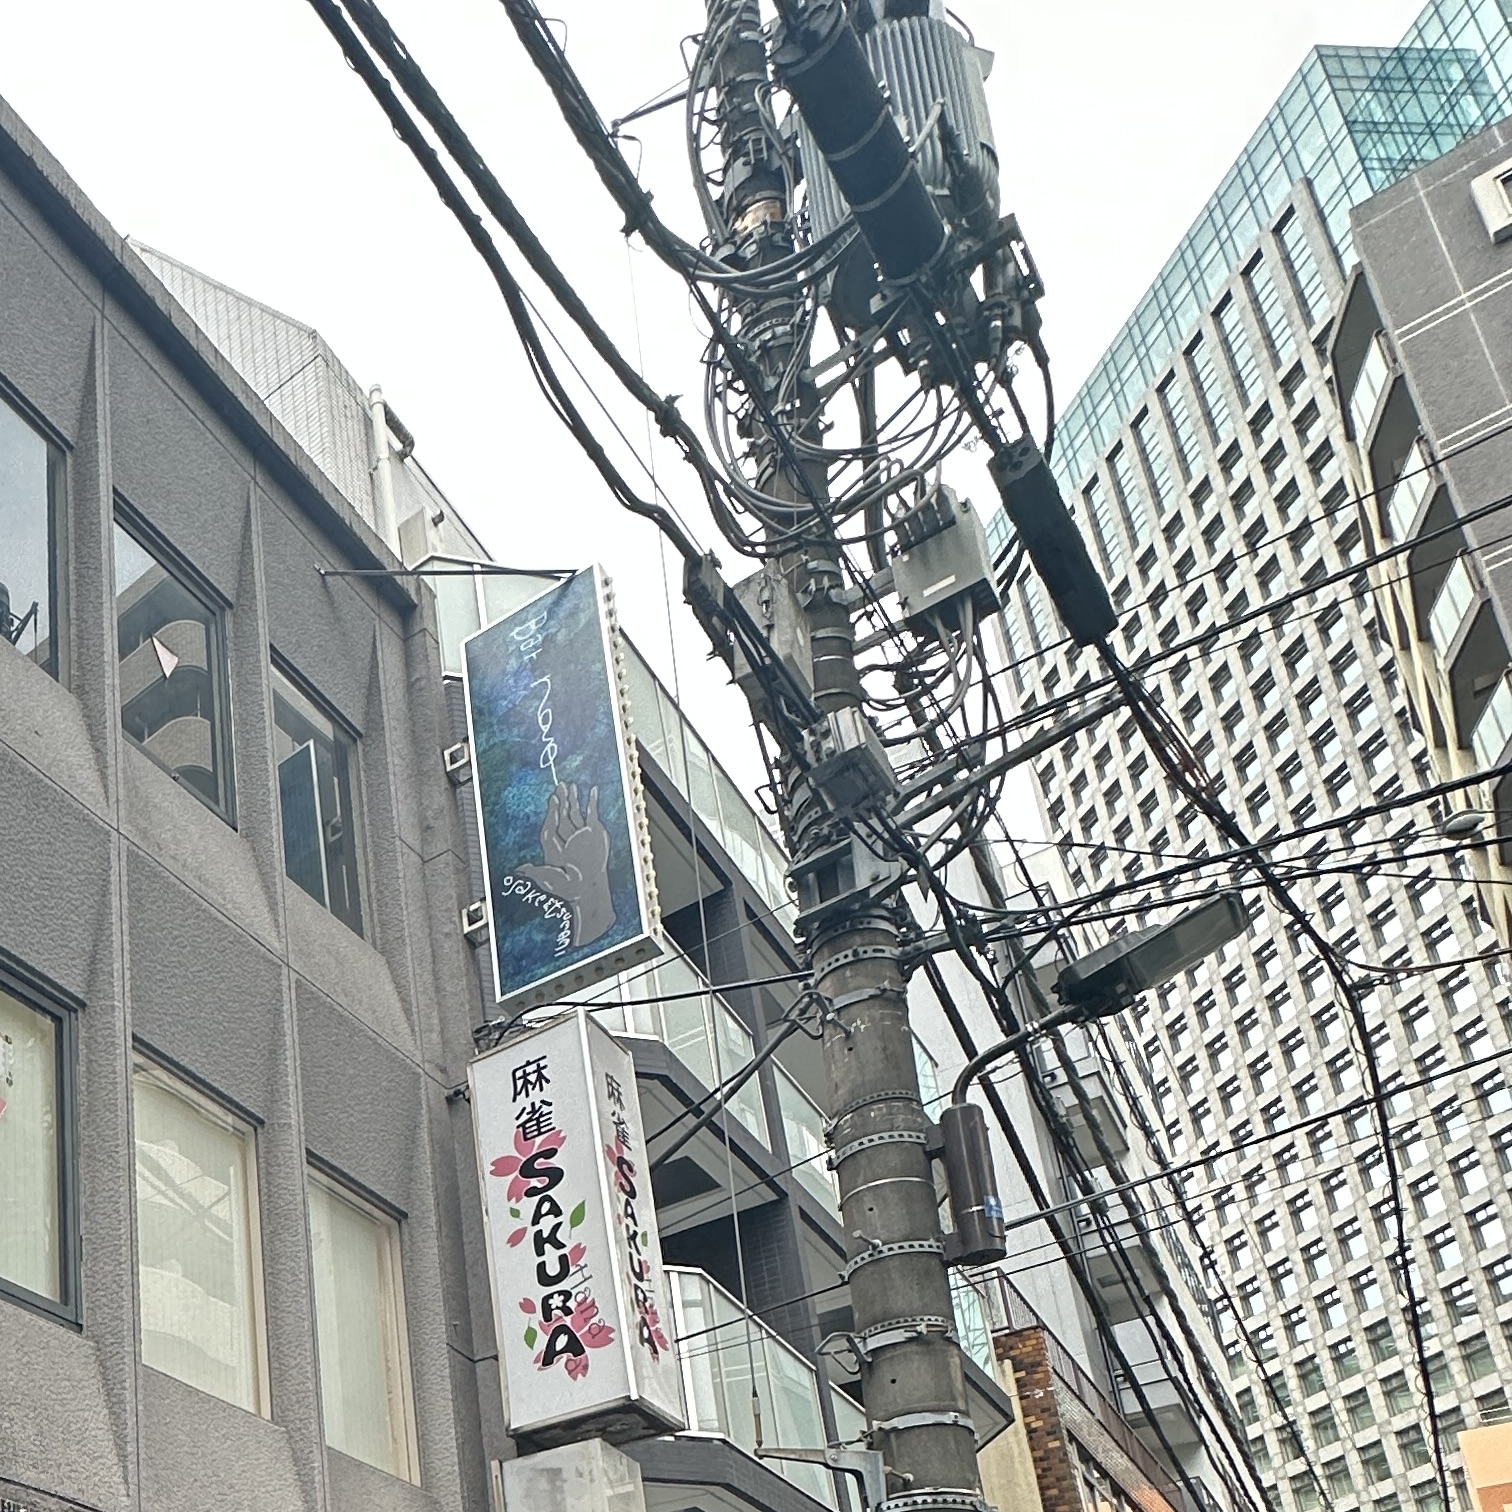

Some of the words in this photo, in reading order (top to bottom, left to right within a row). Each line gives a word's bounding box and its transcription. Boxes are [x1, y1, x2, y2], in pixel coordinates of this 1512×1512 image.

[511, 1055, 556, 1142] 麻雀
[519, 1147, 588, 1368] SAKURA
[616, 1155, 660, 1356] SAKURA
